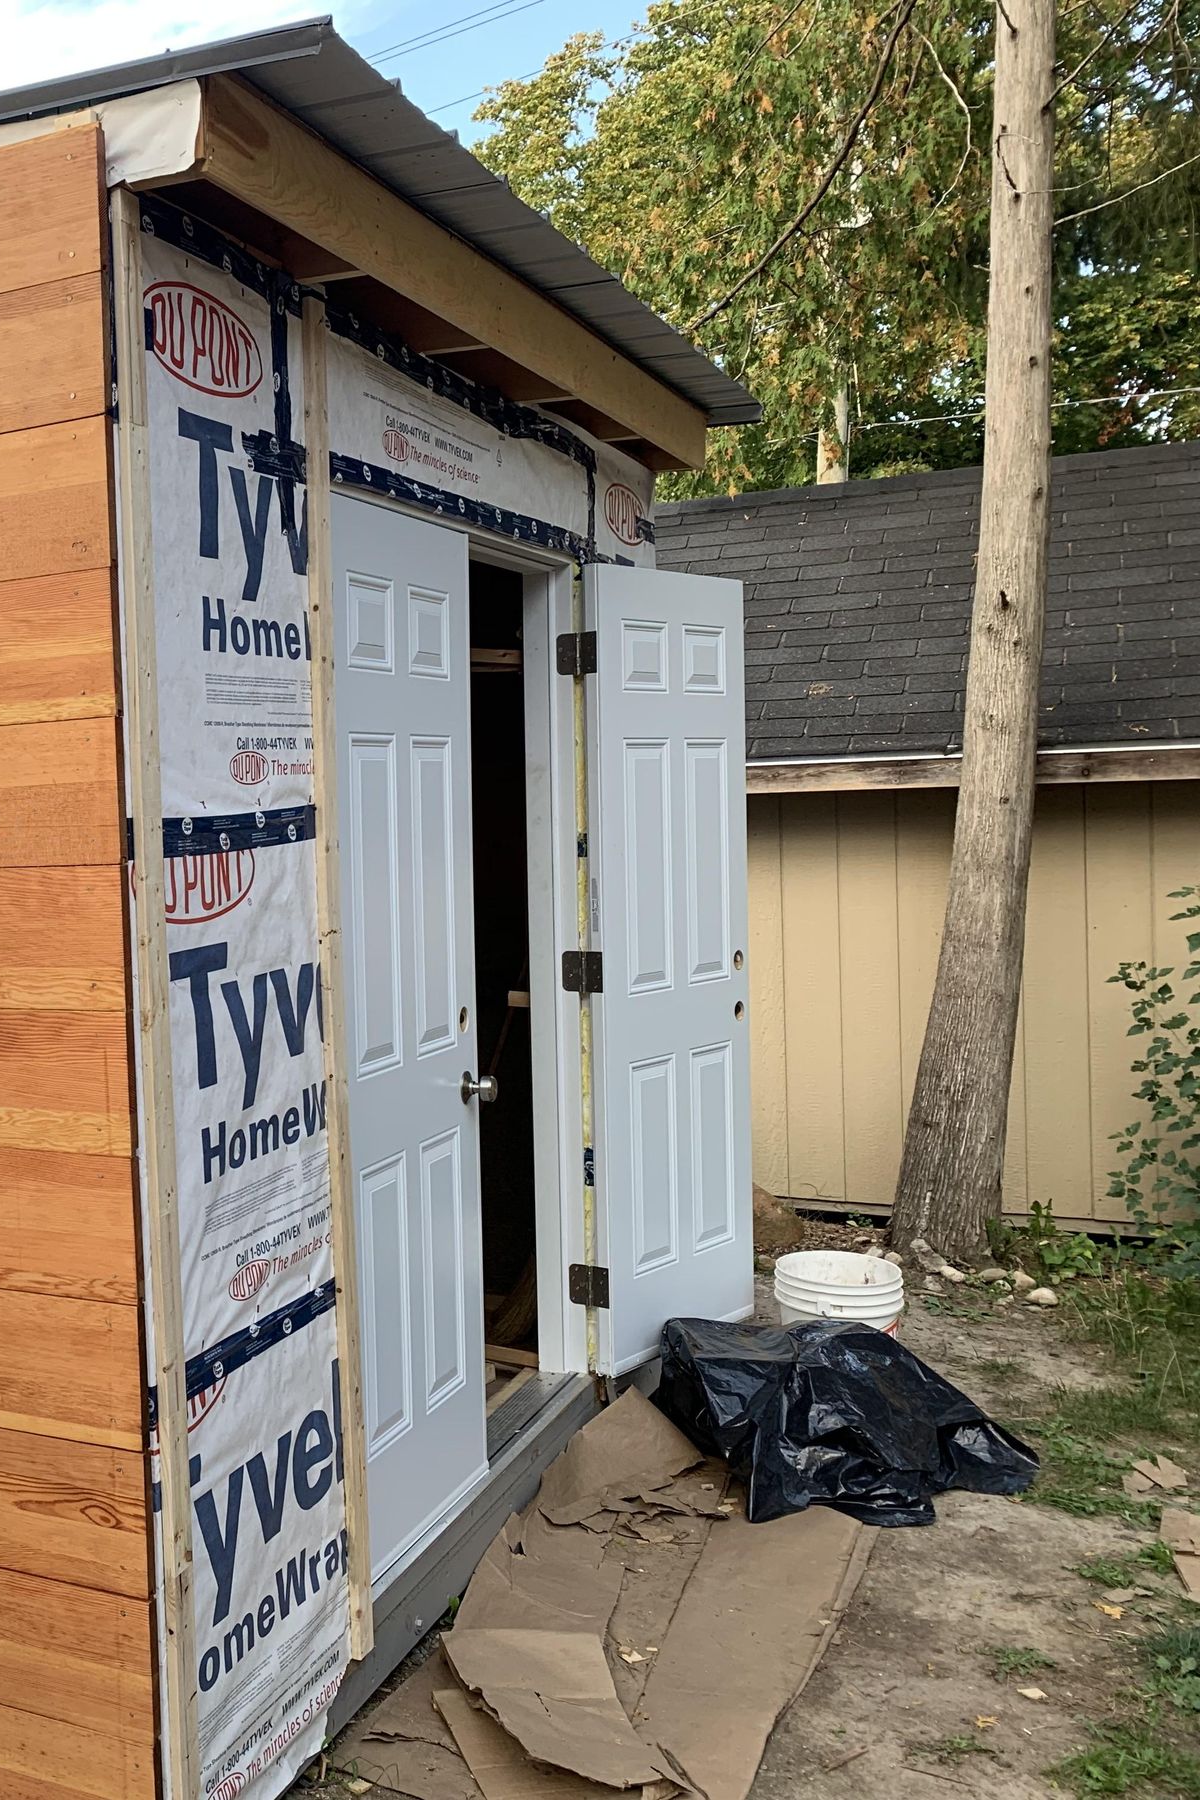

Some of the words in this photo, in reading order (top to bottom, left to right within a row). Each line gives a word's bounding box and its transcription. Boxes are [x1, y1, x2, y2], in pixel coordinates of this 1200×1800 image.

[386, 415, 396, 429] Call
[410, 446, 422, 462] The
[422, 452, 448, 473] miracles
[448, 464, 457, 481] of
[457, 466, 479, 484] science
[202, 596, 311, 661] Home
[236, 737, 250, 750] Call
[251, 737, 297, 750] 1-800-44TYVEK
[271, 759, 288, 776] The
[290, 759, 314, 776] miracl
[169, 942, 324, 1111] Tyv
[236, 1249, 249, 1267] Call
[250, 1223, 301, 1260] 1-800-44TYVEK
[273, 1256, 289, 1275] The
[290, 1236, 323, 1265] miracles
[205, 1772, 220, 1794] Call
[221, 1717, 274, 1777] 1-800-44TYVEK
[246, 1755, 262, 1780] The
[263, 1716, 301, 1767] miracles
[302, 1699, 314, 1726] of
